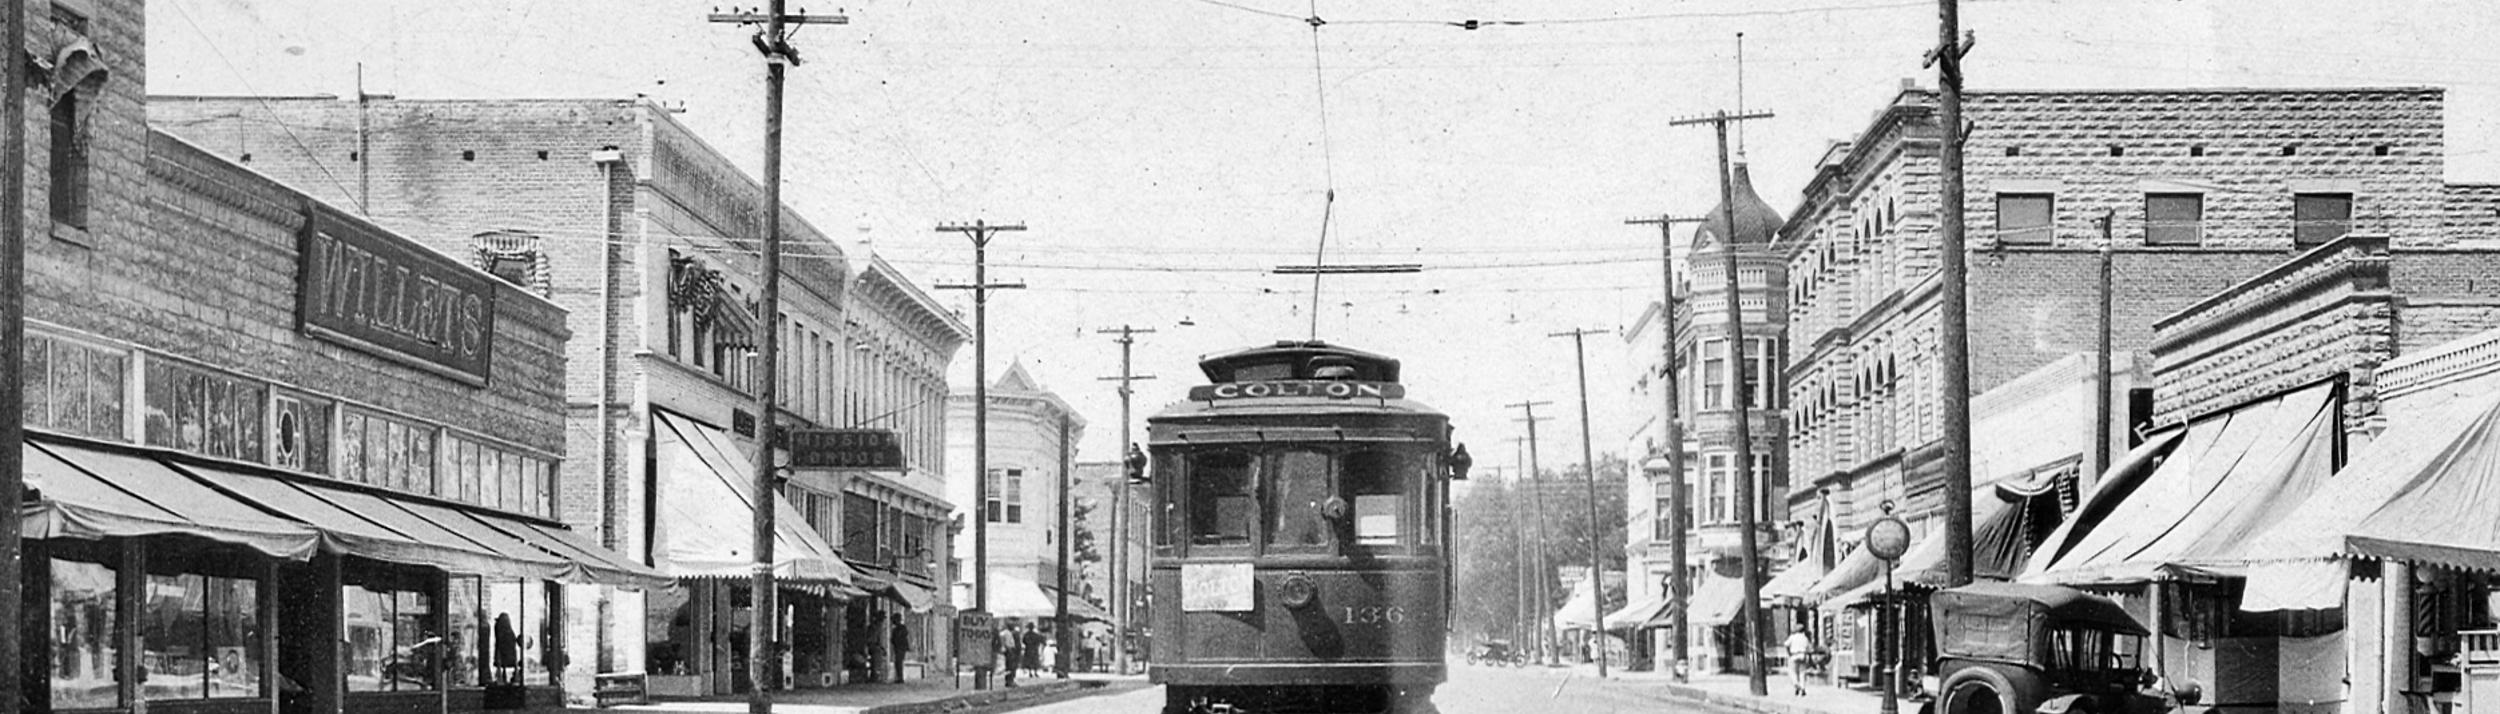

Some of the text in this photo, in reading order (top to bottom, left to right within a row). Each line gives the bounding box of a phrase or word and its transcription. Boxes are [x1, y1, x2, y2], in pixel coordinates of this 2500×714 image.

[317, 231, 485, 357] WILLETS
[1214, 383, 1382, 397] COLTON
[962, 615, 989, 626] BUY
[1343, 606, 1404, 624] 136
